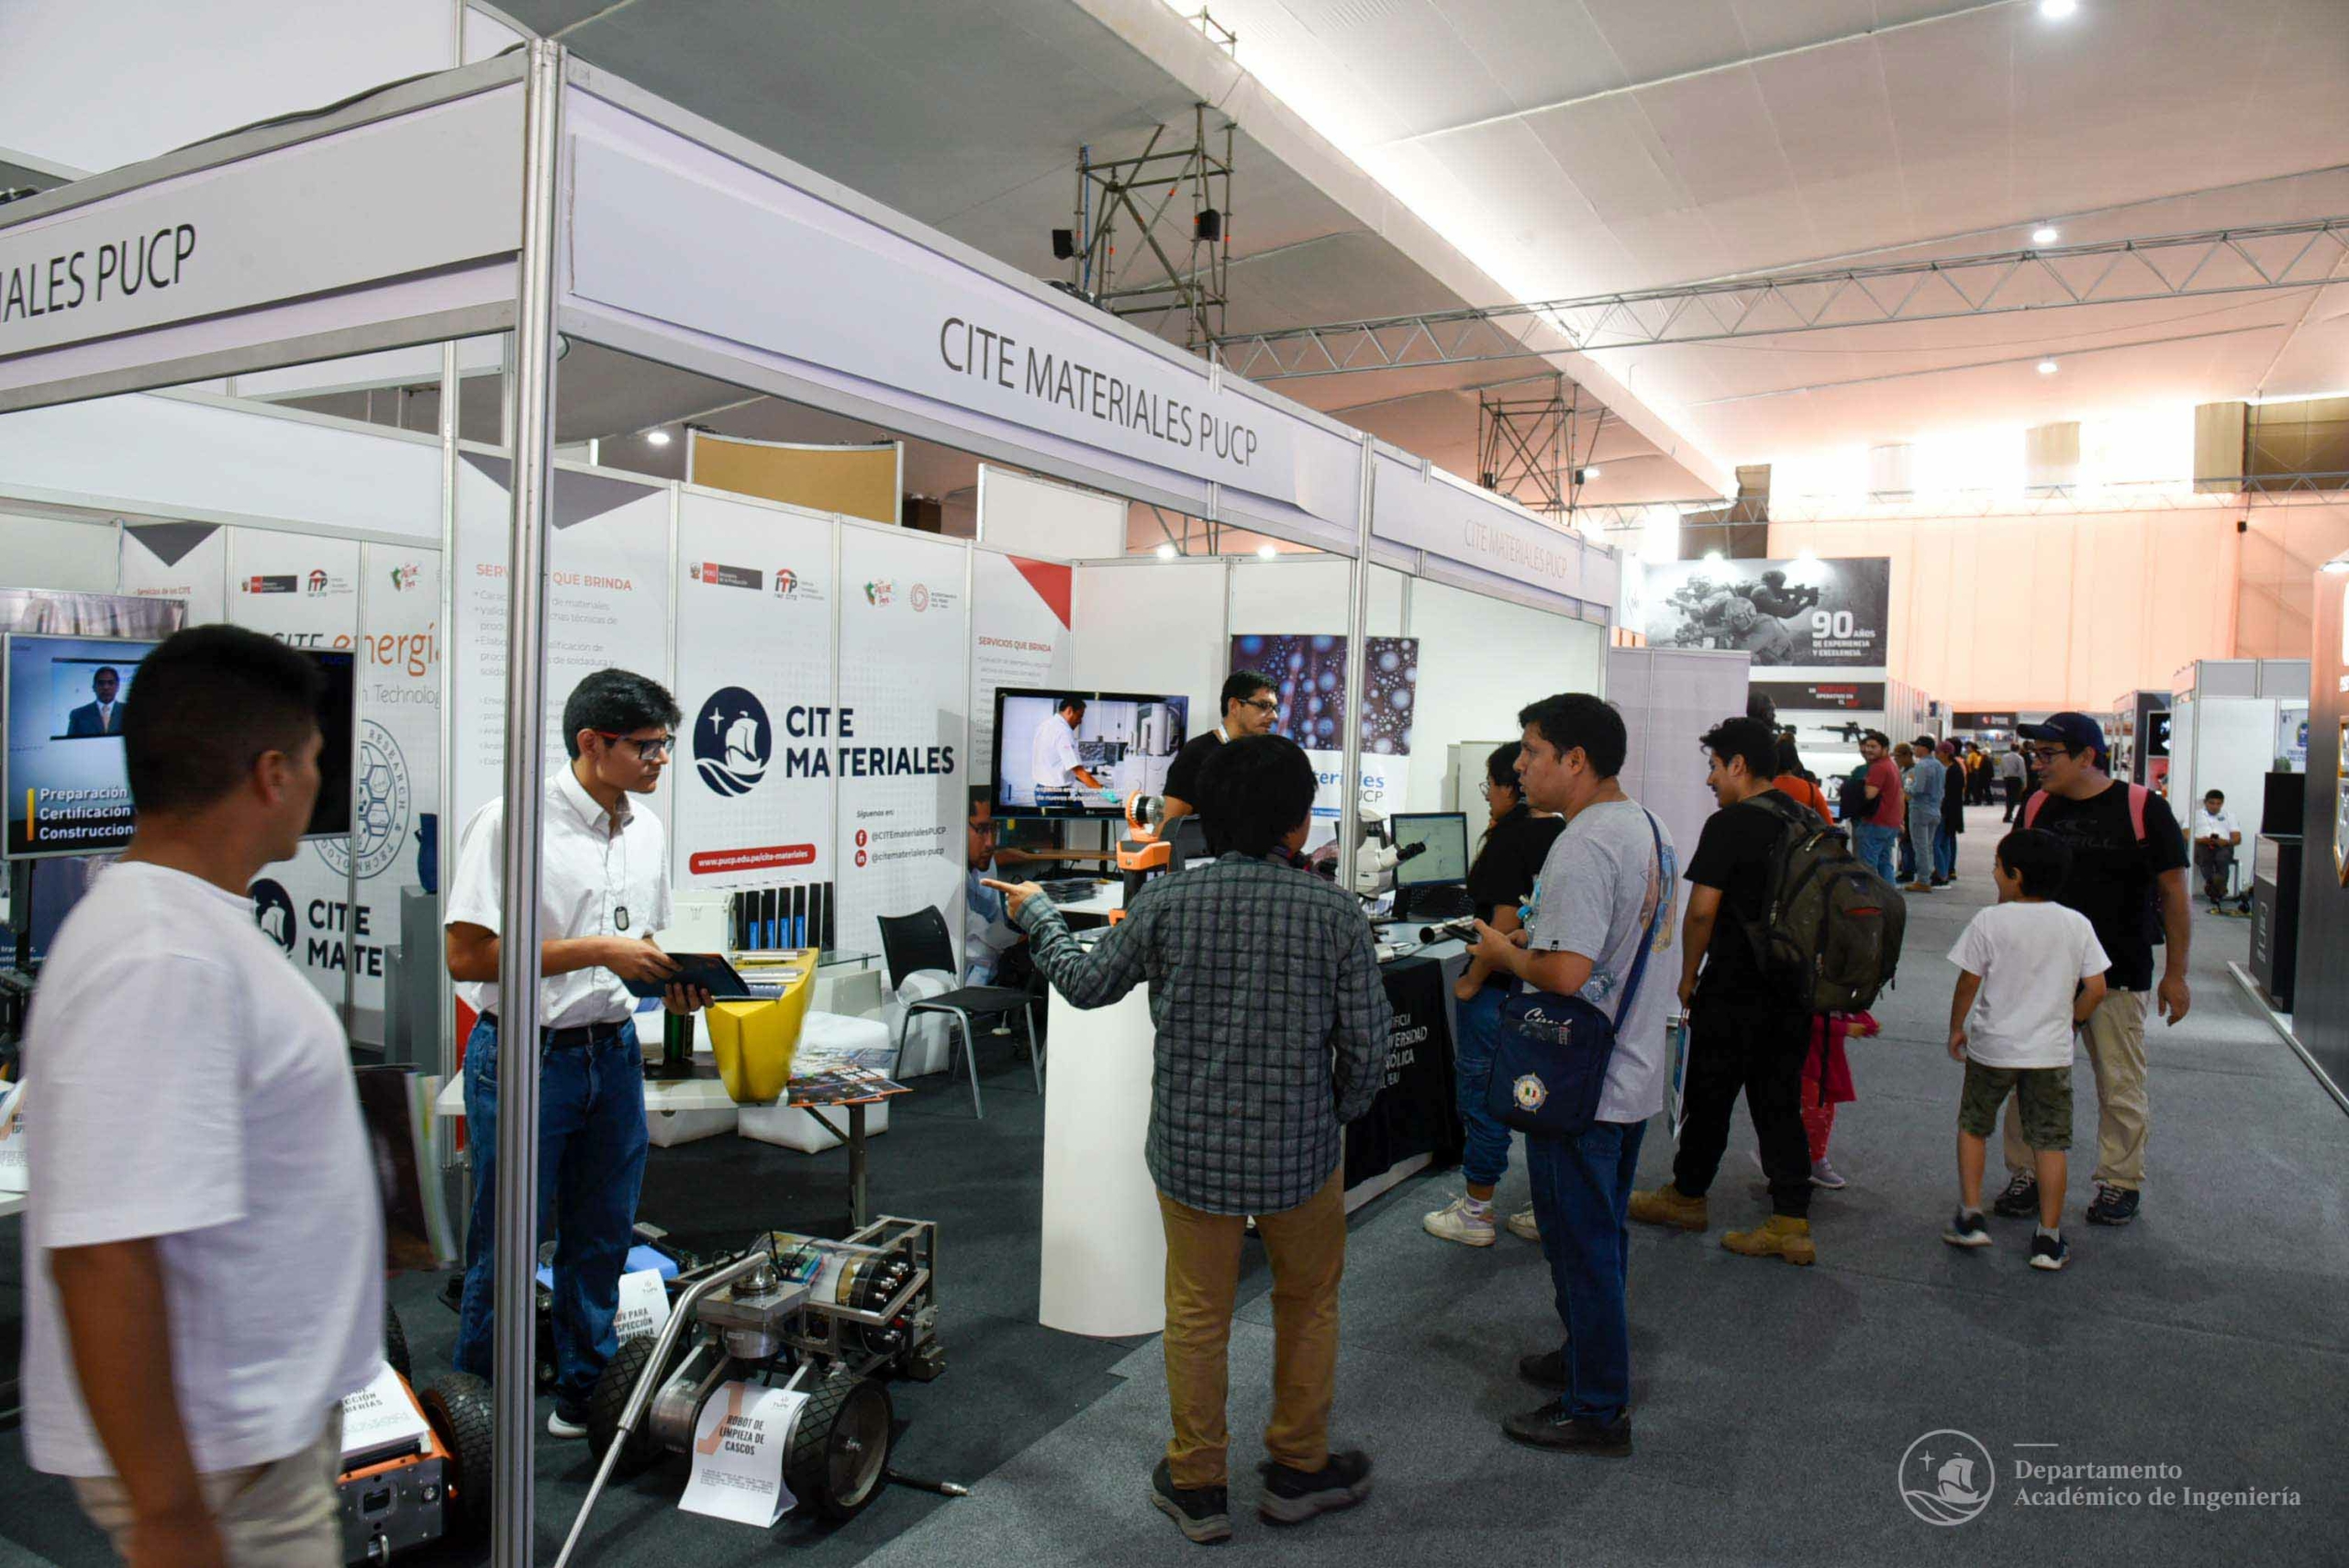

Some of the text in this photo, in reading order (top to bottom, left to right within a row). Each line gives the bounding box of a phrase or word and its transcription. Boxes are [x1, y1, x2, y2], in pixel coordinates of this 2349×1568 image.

[96, 223, 195, 302] PUCP
[940, 317, 1258, 467] CITE MATERIALES PUCP
[552, 572, 580, 586] QUE
[584, 575, 632, 592] BRINDA
[774, 577, 798, 594] ITP
[1811, 610, 1854, 639] 90
[332, 621, 440, 677] energí
[786, 706, 854, 738] CITE
[785, 745, 954, 778] MATERIALES
[39, 786, 128, 803] Preparación
[39, 805, 131, 820] Certificación
[39, 825, 137, 840] Construccion
[697, 851, 808, 868] www.pucp.edu.pe/cite-materiales
[308, 899, 371, 936] CITE
[307, 937, 383, 977] MATE
[628, 1307, 648, 1318] PARA
[727, 1414, 764, 1431] ROBOT DE
[719, 1427, 765, 1445] LIMPIEZA DE
[725, 1440, 755, 1455] CASCOS
